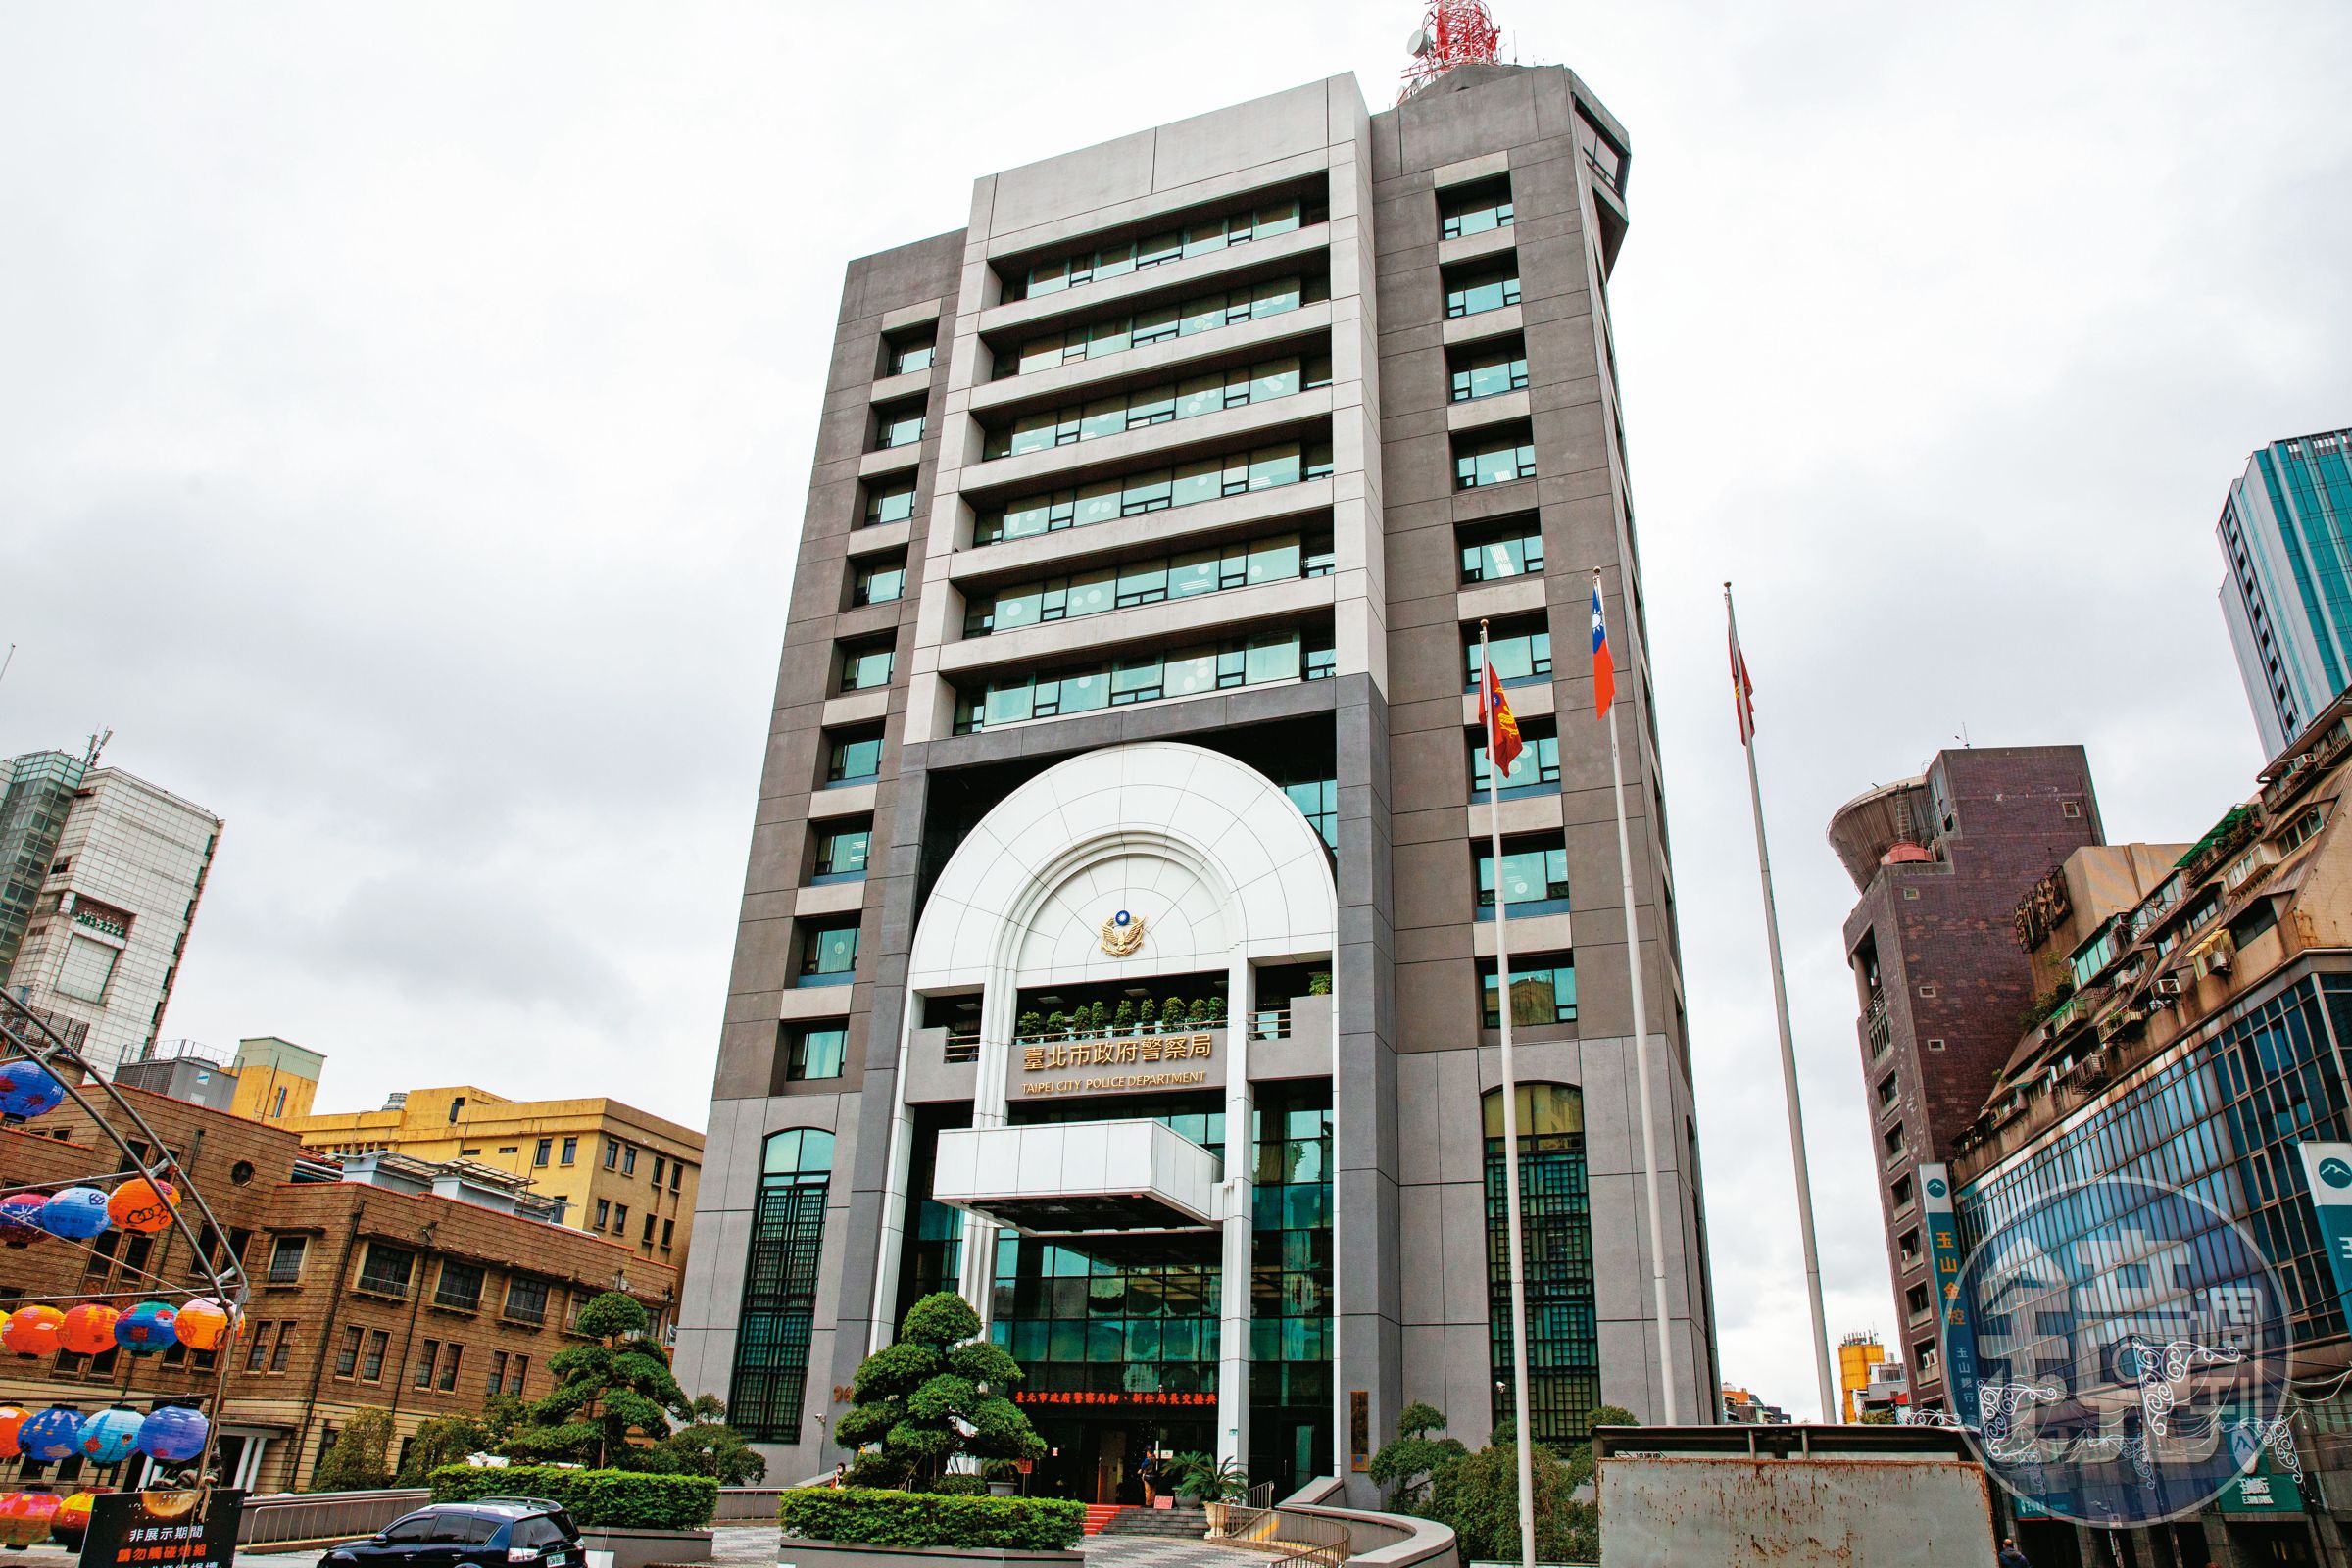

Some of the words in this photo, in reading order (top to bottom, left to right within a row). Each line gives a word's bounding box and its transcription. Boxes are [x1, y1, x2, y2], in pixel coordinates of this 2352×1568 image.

[1022, 1033, 1212, 1070] 臺北市政府警察局
[1022, 1081, 1054, 1094] TAIPEI
[1057, 1079, 1081, 1092] CITY
[1086, 1077, 1125, 1089] POLICE
[1128, 1071, 1205, 1086] DEPARTMENT
[1936, 1231, 1966, 1326] 玉山金控
[129, 1525, 204, 1543] 非展示期間
